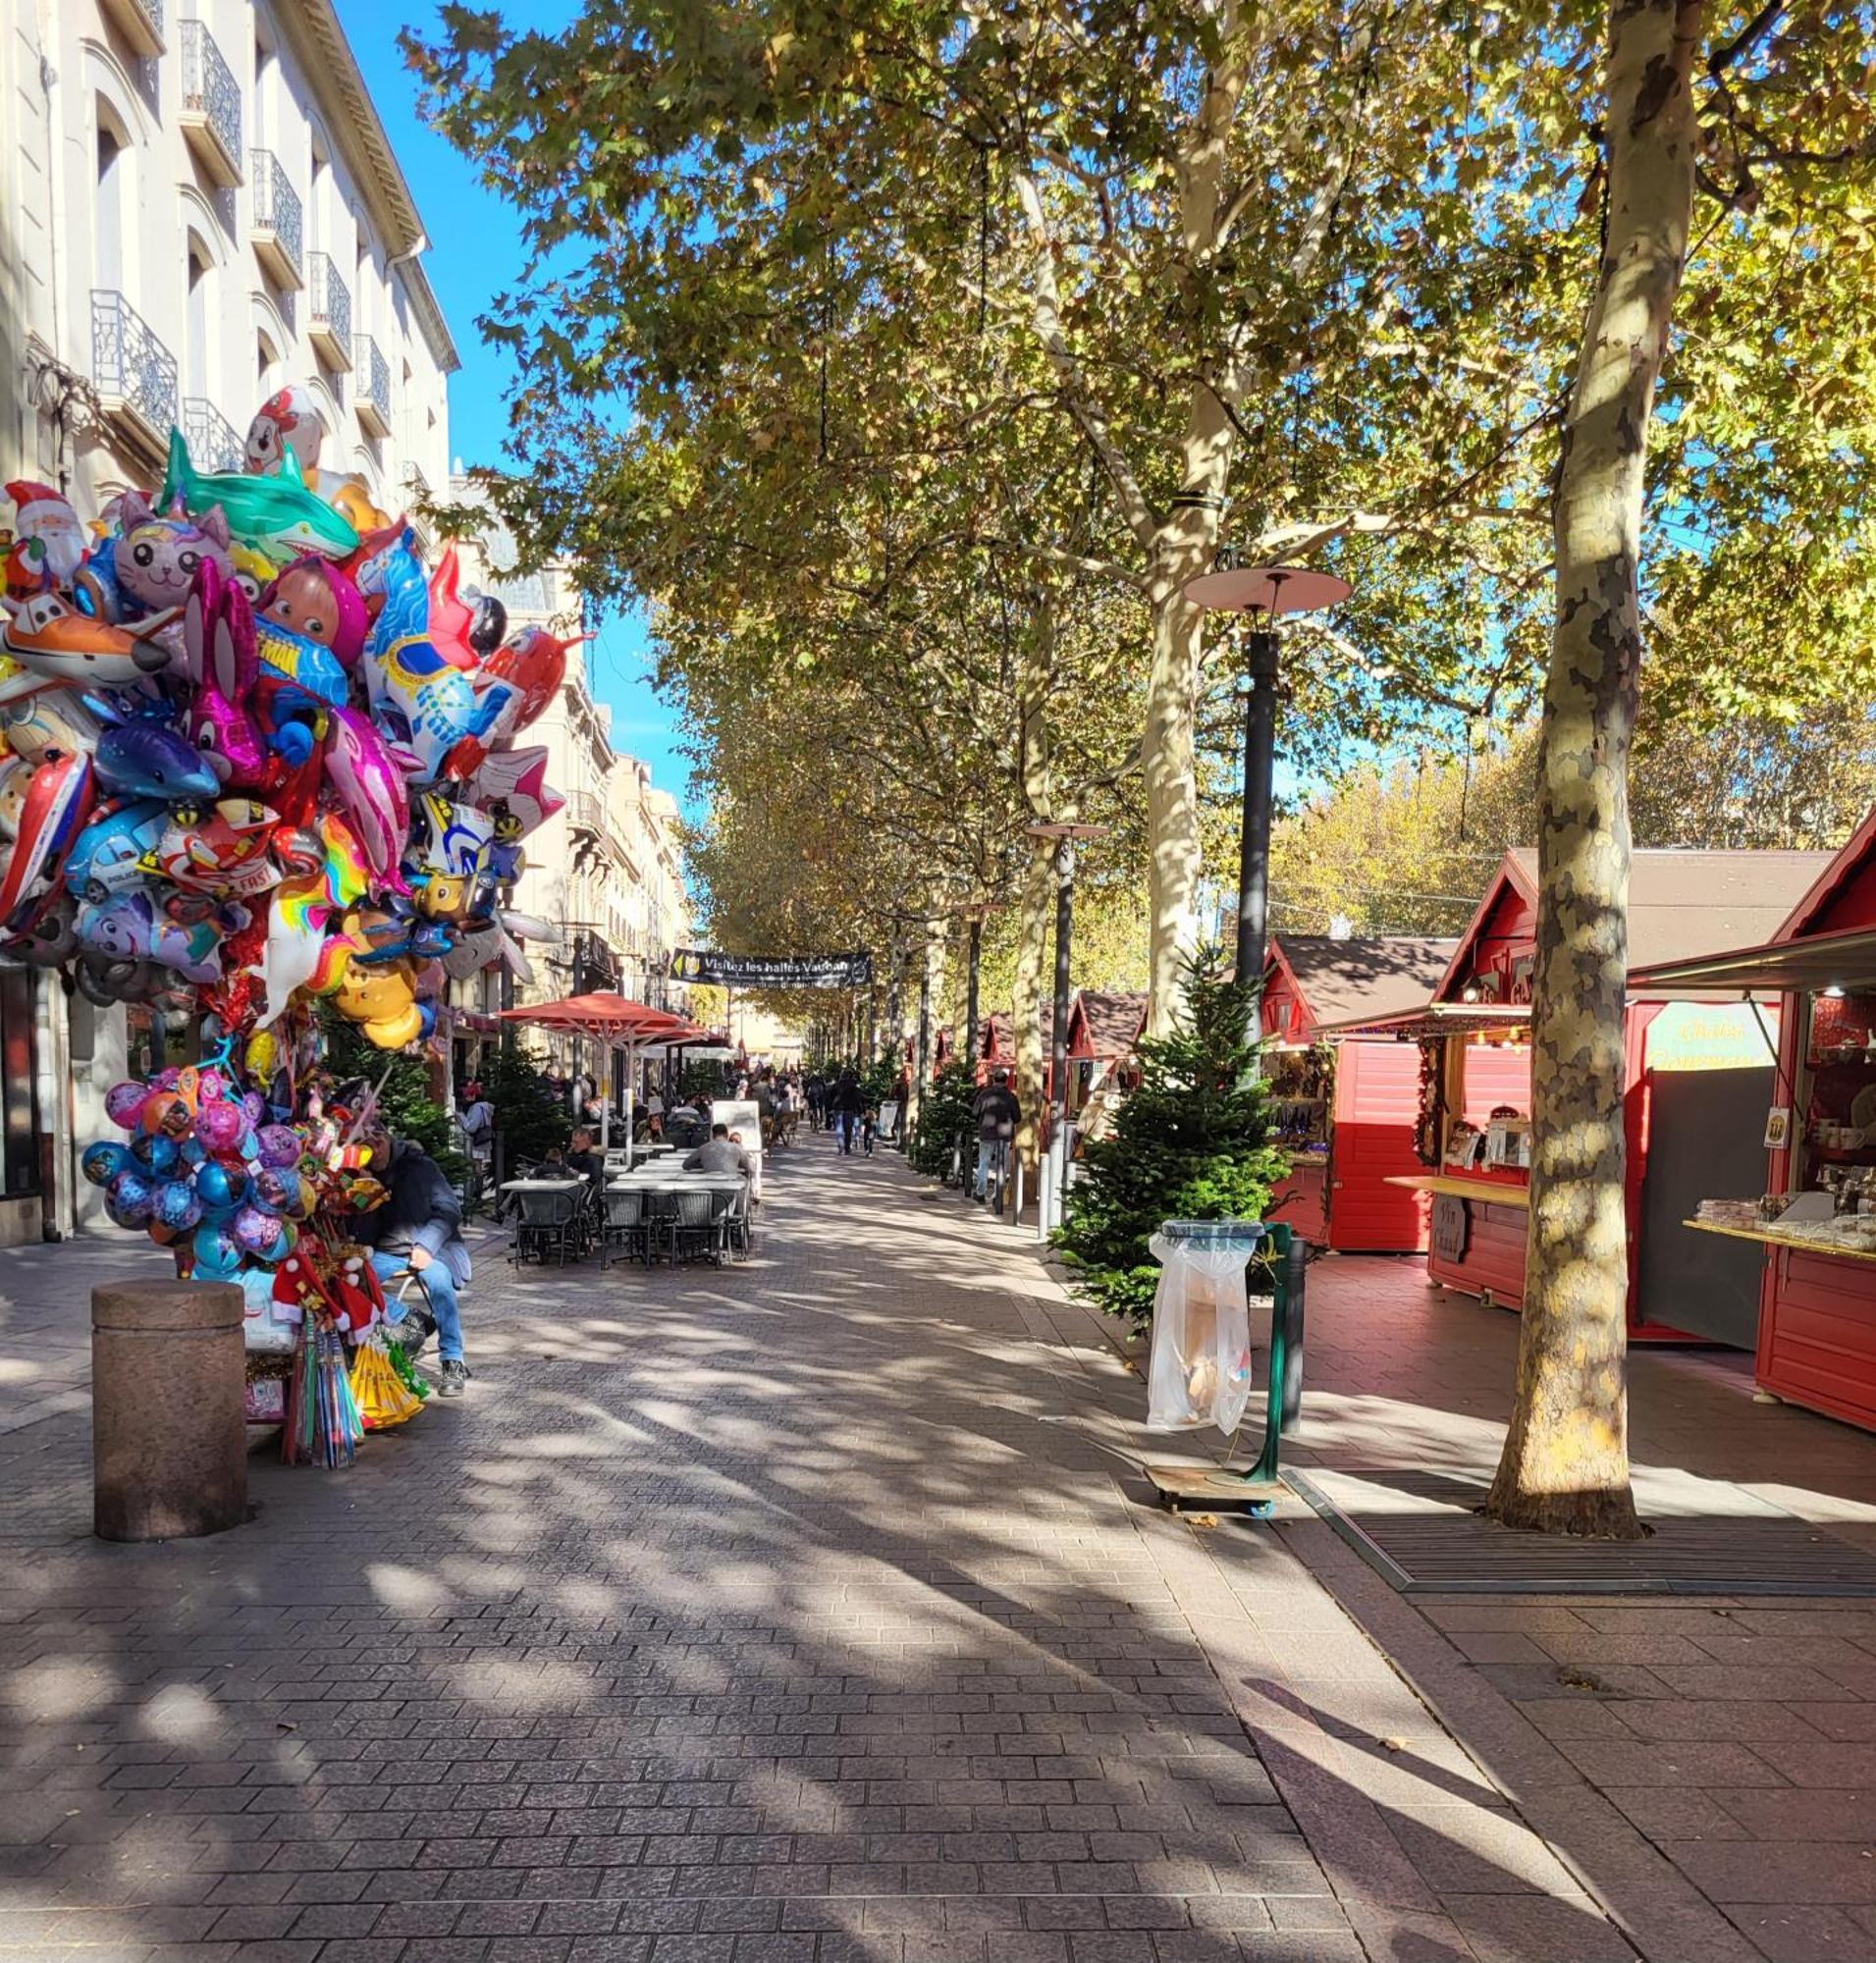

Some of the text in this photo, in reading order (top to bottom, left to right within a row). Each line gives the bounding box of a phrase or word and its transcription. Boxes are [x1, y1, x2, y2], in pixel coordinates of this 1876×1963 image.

[107, 870, 138, 882] POLICE
[241, 867, 271, 890] FAST
[705, 957, 849, 974] Visitez les halles Vauban
